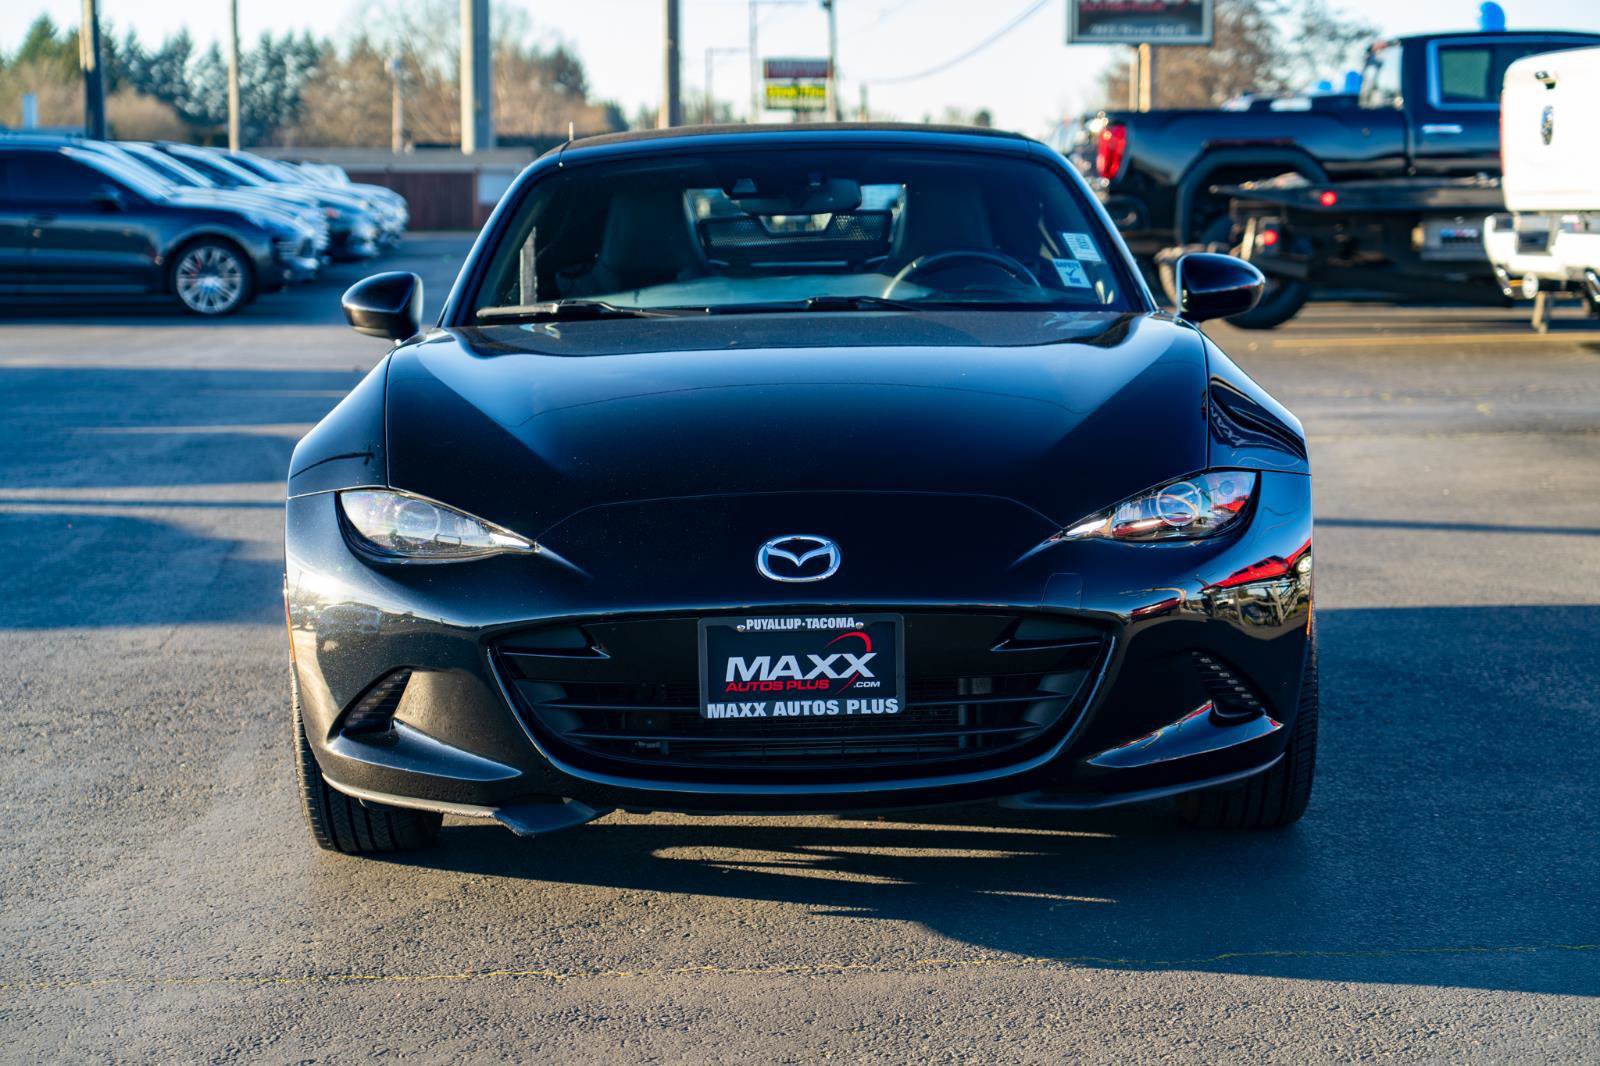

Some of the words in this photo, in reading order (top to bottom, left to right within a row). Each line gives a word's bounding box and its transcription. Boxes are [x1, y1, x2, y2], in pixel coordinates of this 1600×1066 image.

[725, 652, 878, 682] MAXX
[725, 681, 783, 692] AUTOS
[786, 680, 830, 691] PLUS
[706, 703, 767, 719] MAXX
[773, 701, 839, 716] AUTOS
[846, 698, 899, 714] PLUS
